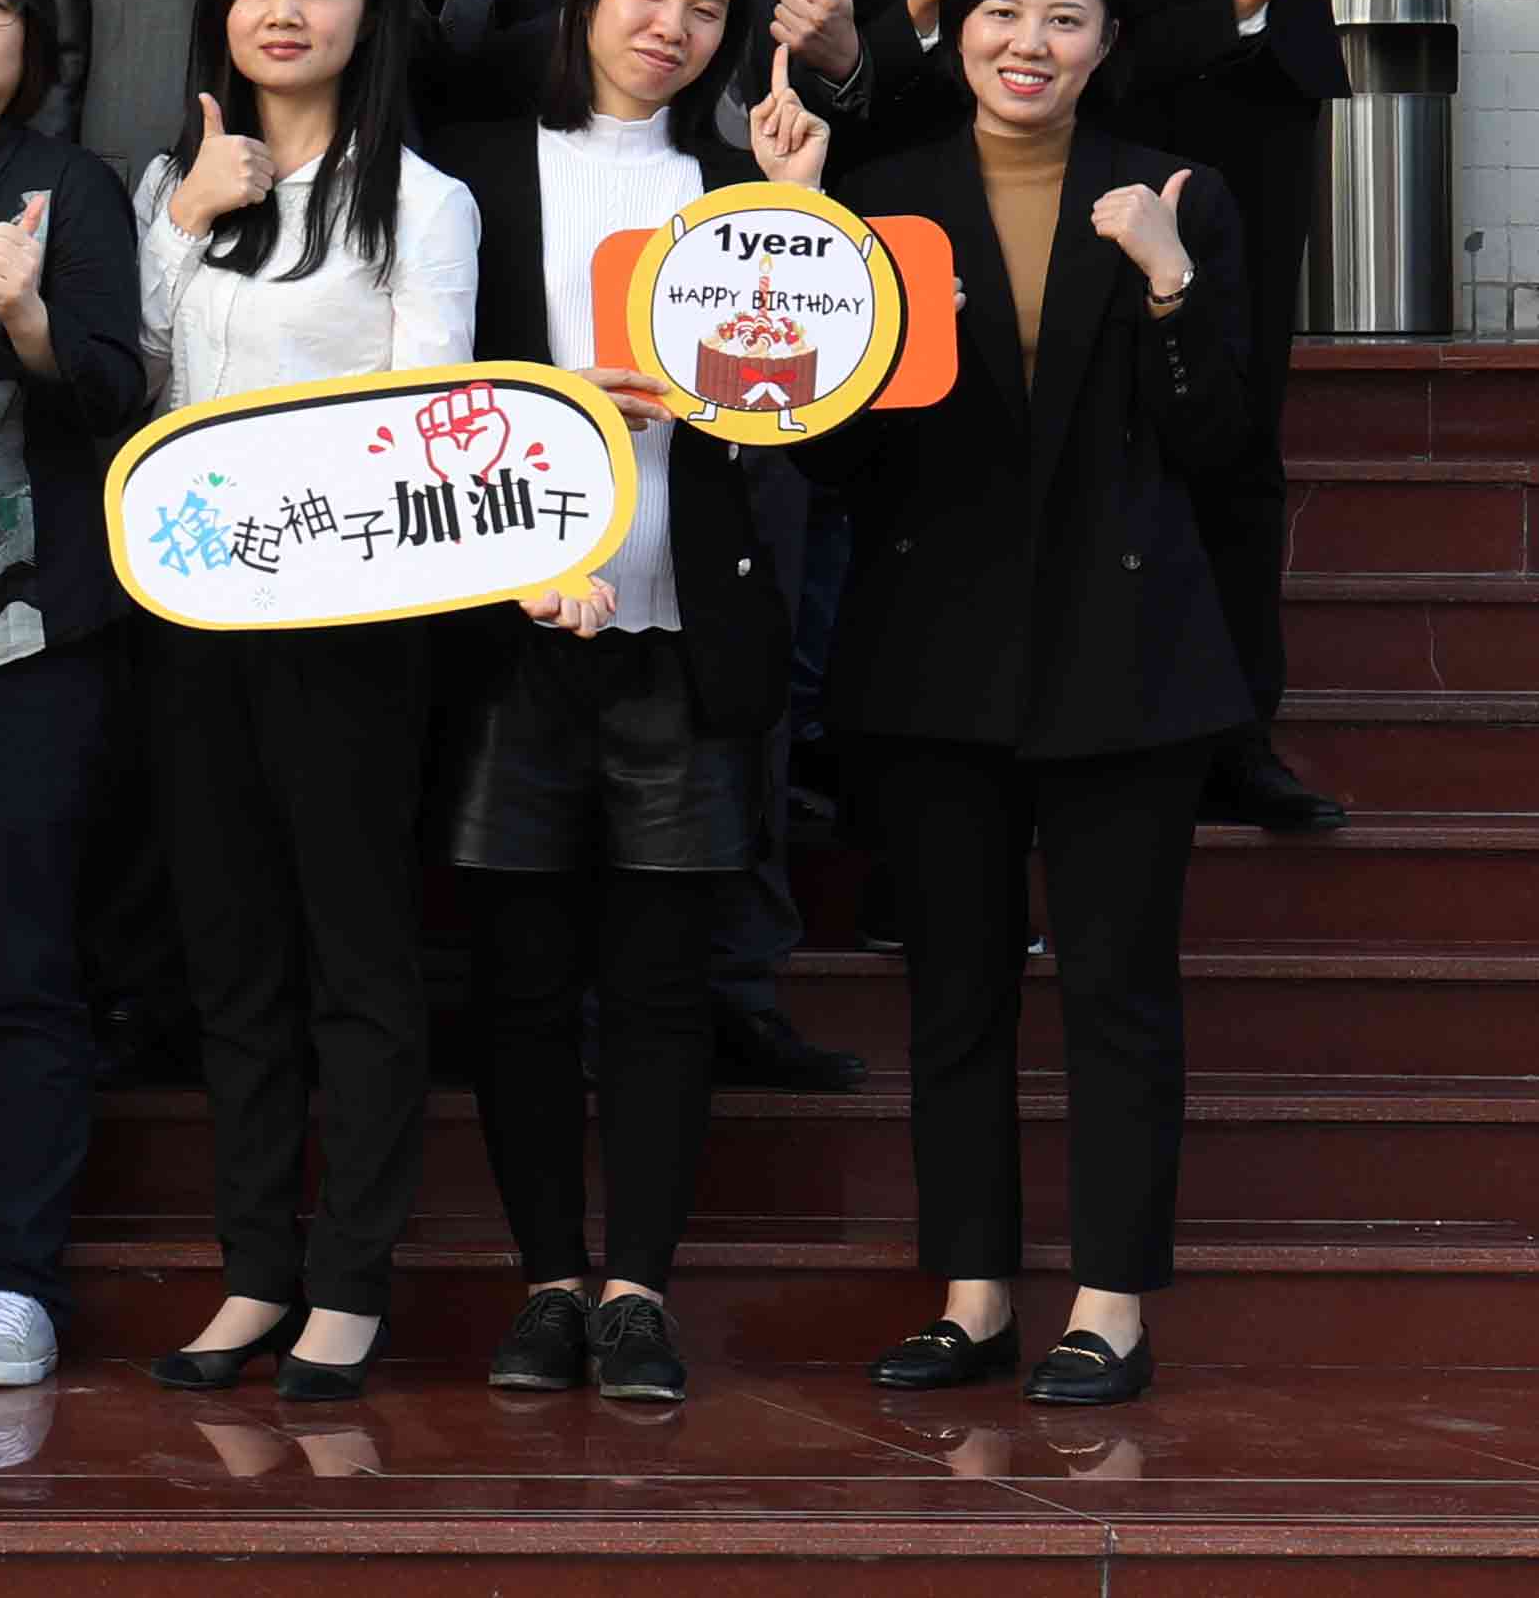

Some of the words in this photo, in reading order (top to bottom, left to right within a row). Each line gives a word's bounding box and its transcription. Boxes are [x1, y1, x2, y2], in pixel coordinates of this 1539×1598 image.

[714, 223, 834, 261] 1year
[668, 285, 742, 308] HAPPY
[751, 289, 865, 316] BIRTHDAY
[147, 468, 590, 577] 撸起袖子加油干
